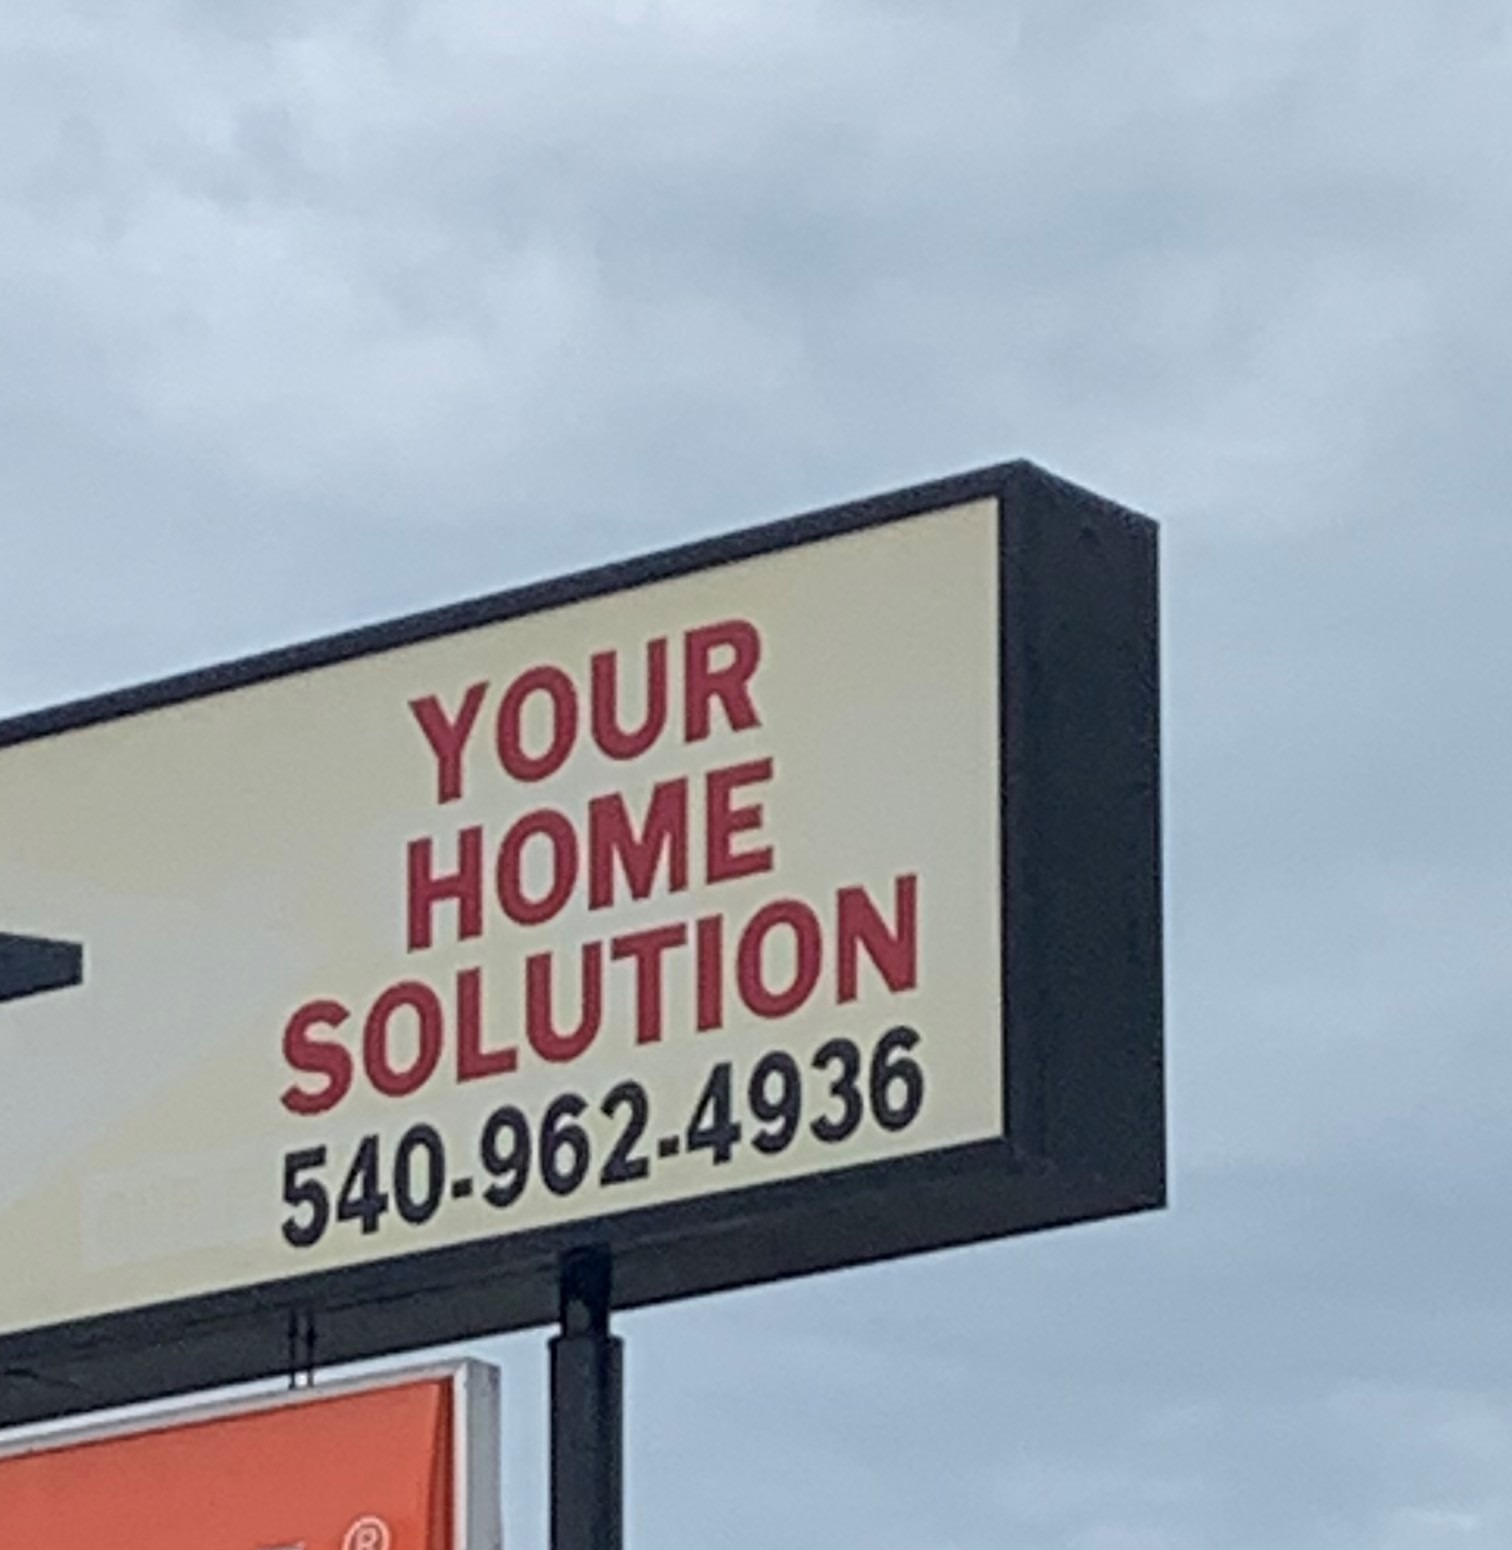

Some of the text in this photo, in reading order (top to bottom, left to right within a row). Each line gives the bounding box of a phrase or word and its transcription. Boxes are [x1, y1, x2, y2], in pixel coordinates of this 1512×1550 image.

[408, 619, 762, 804] YOUR
[407, 757, 774, 953] HOME
[281, 874, 918, 1116] SOLUTION
[281, 1026, 924, 1247] 540-962-4936
